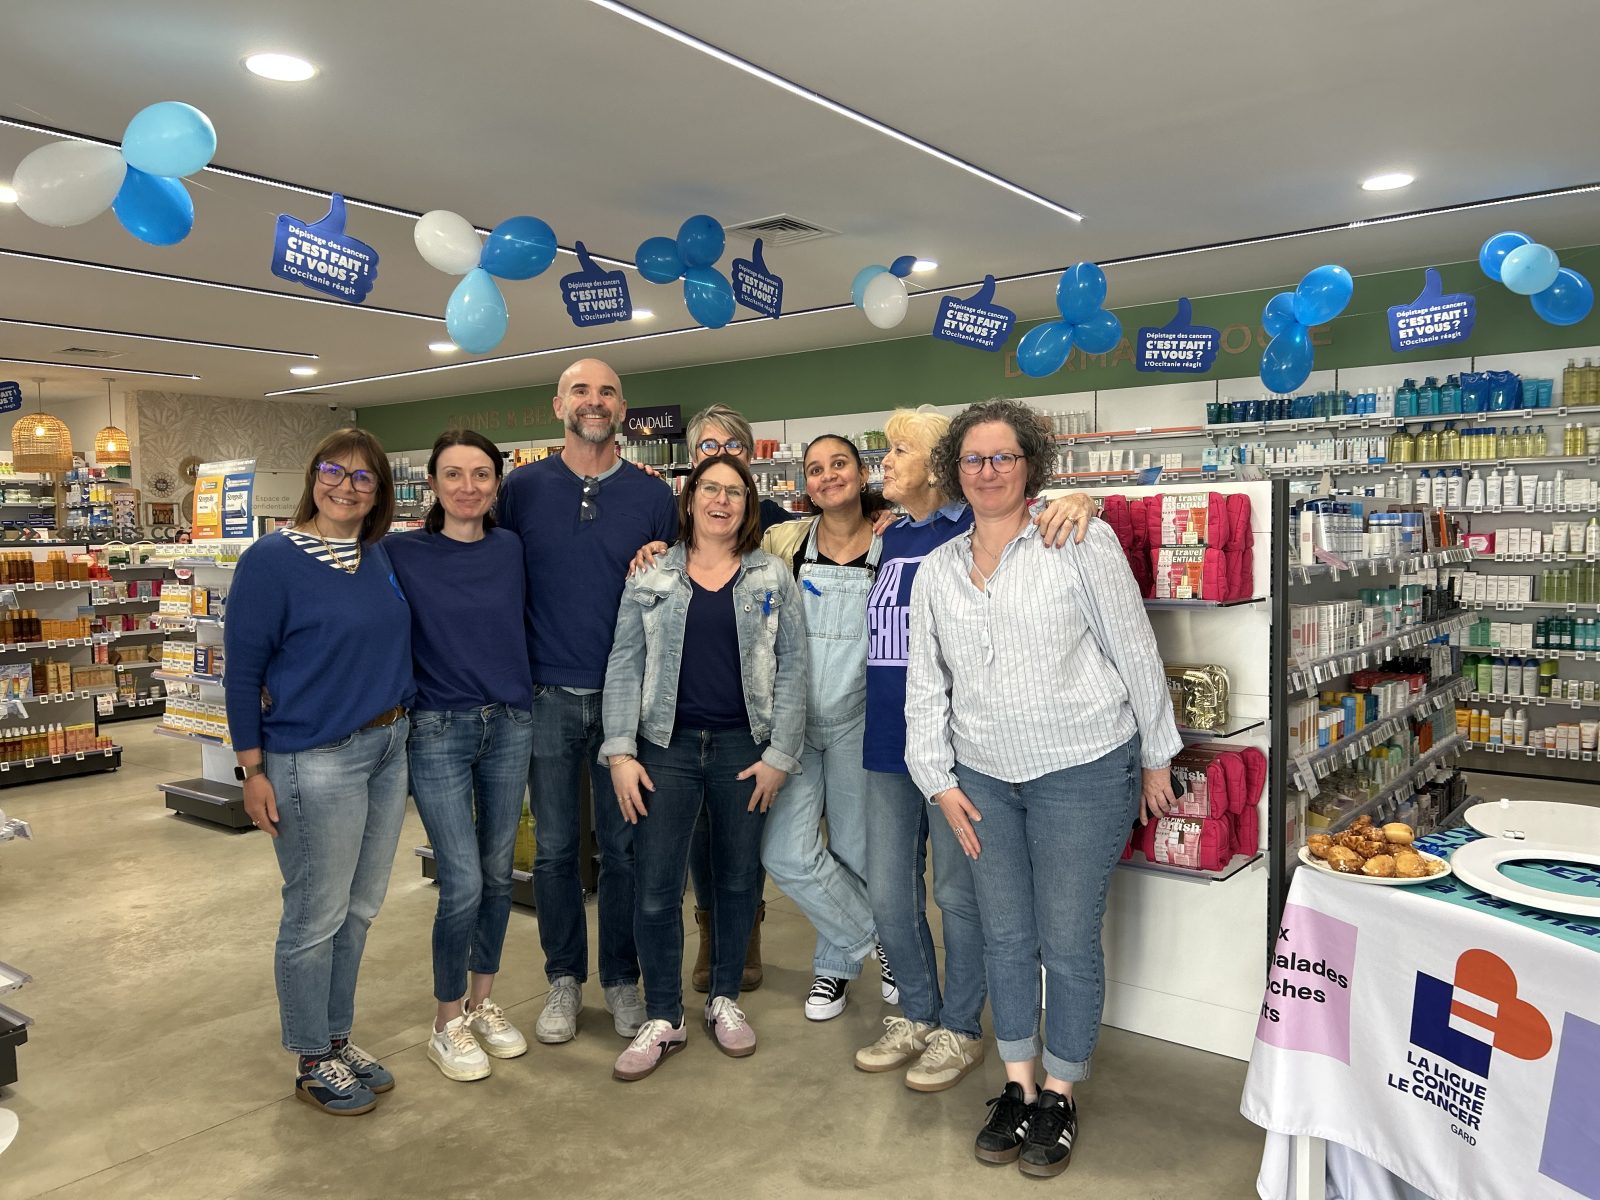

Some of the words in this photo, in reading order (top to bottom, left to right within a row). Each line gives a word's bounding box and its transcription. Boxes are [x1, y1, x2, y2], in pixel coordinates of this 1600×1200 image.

[289, 224, 326, 245] Dépistage
[328, 241, 341, 251] des
[342, 246, 370, 261] cancers
[287, 236, 329, 260] C'EST
[330, 252, 361, 272] FAIT
[285, 250, 305, 266] ET
[306, 257, 347, 281] VOUS
[284, 264, 330, 286] L'Occitanie
[332, 282, 356, 295] réagit
[738, 272, 758, 287] C'EST
[759, 280, 774, 295] FAIT
[570, 290, 596, 301] C'EST
[598, 288, 618, 298] FAIT
[742, 284, 751, 294] ET
[752, 288, 772, 303] VOUS
[578, 302, 590, 312] ET
[591, 299, 617, 311] VOUS
[949, 302, 975, 313] Dépistage
[987, 312, 1008, 320] cancers
[1396, 308, 1428, 318] Dépistage
[1442, 301, 1467, 310] cancers
[946, 310, 976, 323] C'EST
[977, 316, 1001, 329] FAIT
[1398, 315, 1432, 328] C'EST
[1434, 309, 1461, 322] FAIT
[944, 319, 958, 329] ET
[958, 322, 988, 337] VOUS
[1399, 328, 1414, 339] ET
[1415, 321, 1451, 336] VOUS
[941, 329, 974, 341] L'Occitanie
[976, 338, 994, 346] réagit
[1146, 340, 1178, 350] C'EST
[1180, 341, 1205, 350] FAIT
[1400, 335, 1439, 346] L'Occitanie
[1441, 331, 1462, 340] réagit
[1145, 350, 1159, 359] ET
[1161, 350, 1194, 360] VOUS
[0, 390, 12, 398] AIT
[1162, 502, 1207, 510] ESSENTIALS
[1178, 494, 1206, 502] travel
[1159, 820, 1201, 833] crush
[1517, 910, 1600, 938] ma
[1279, 927, 1290, 941] x
[1407, 1050, 1430, 1072] LA
[1434, 1063, 1487, 1100] LIGUE
[1388, 1073, 1410, 1093] LE
[1412, 1084, 1481, 1131] CANCER
[1412, 1070, 1484, 1116] CONTRE
[1450, 1124, 1477, 1146] GARD
